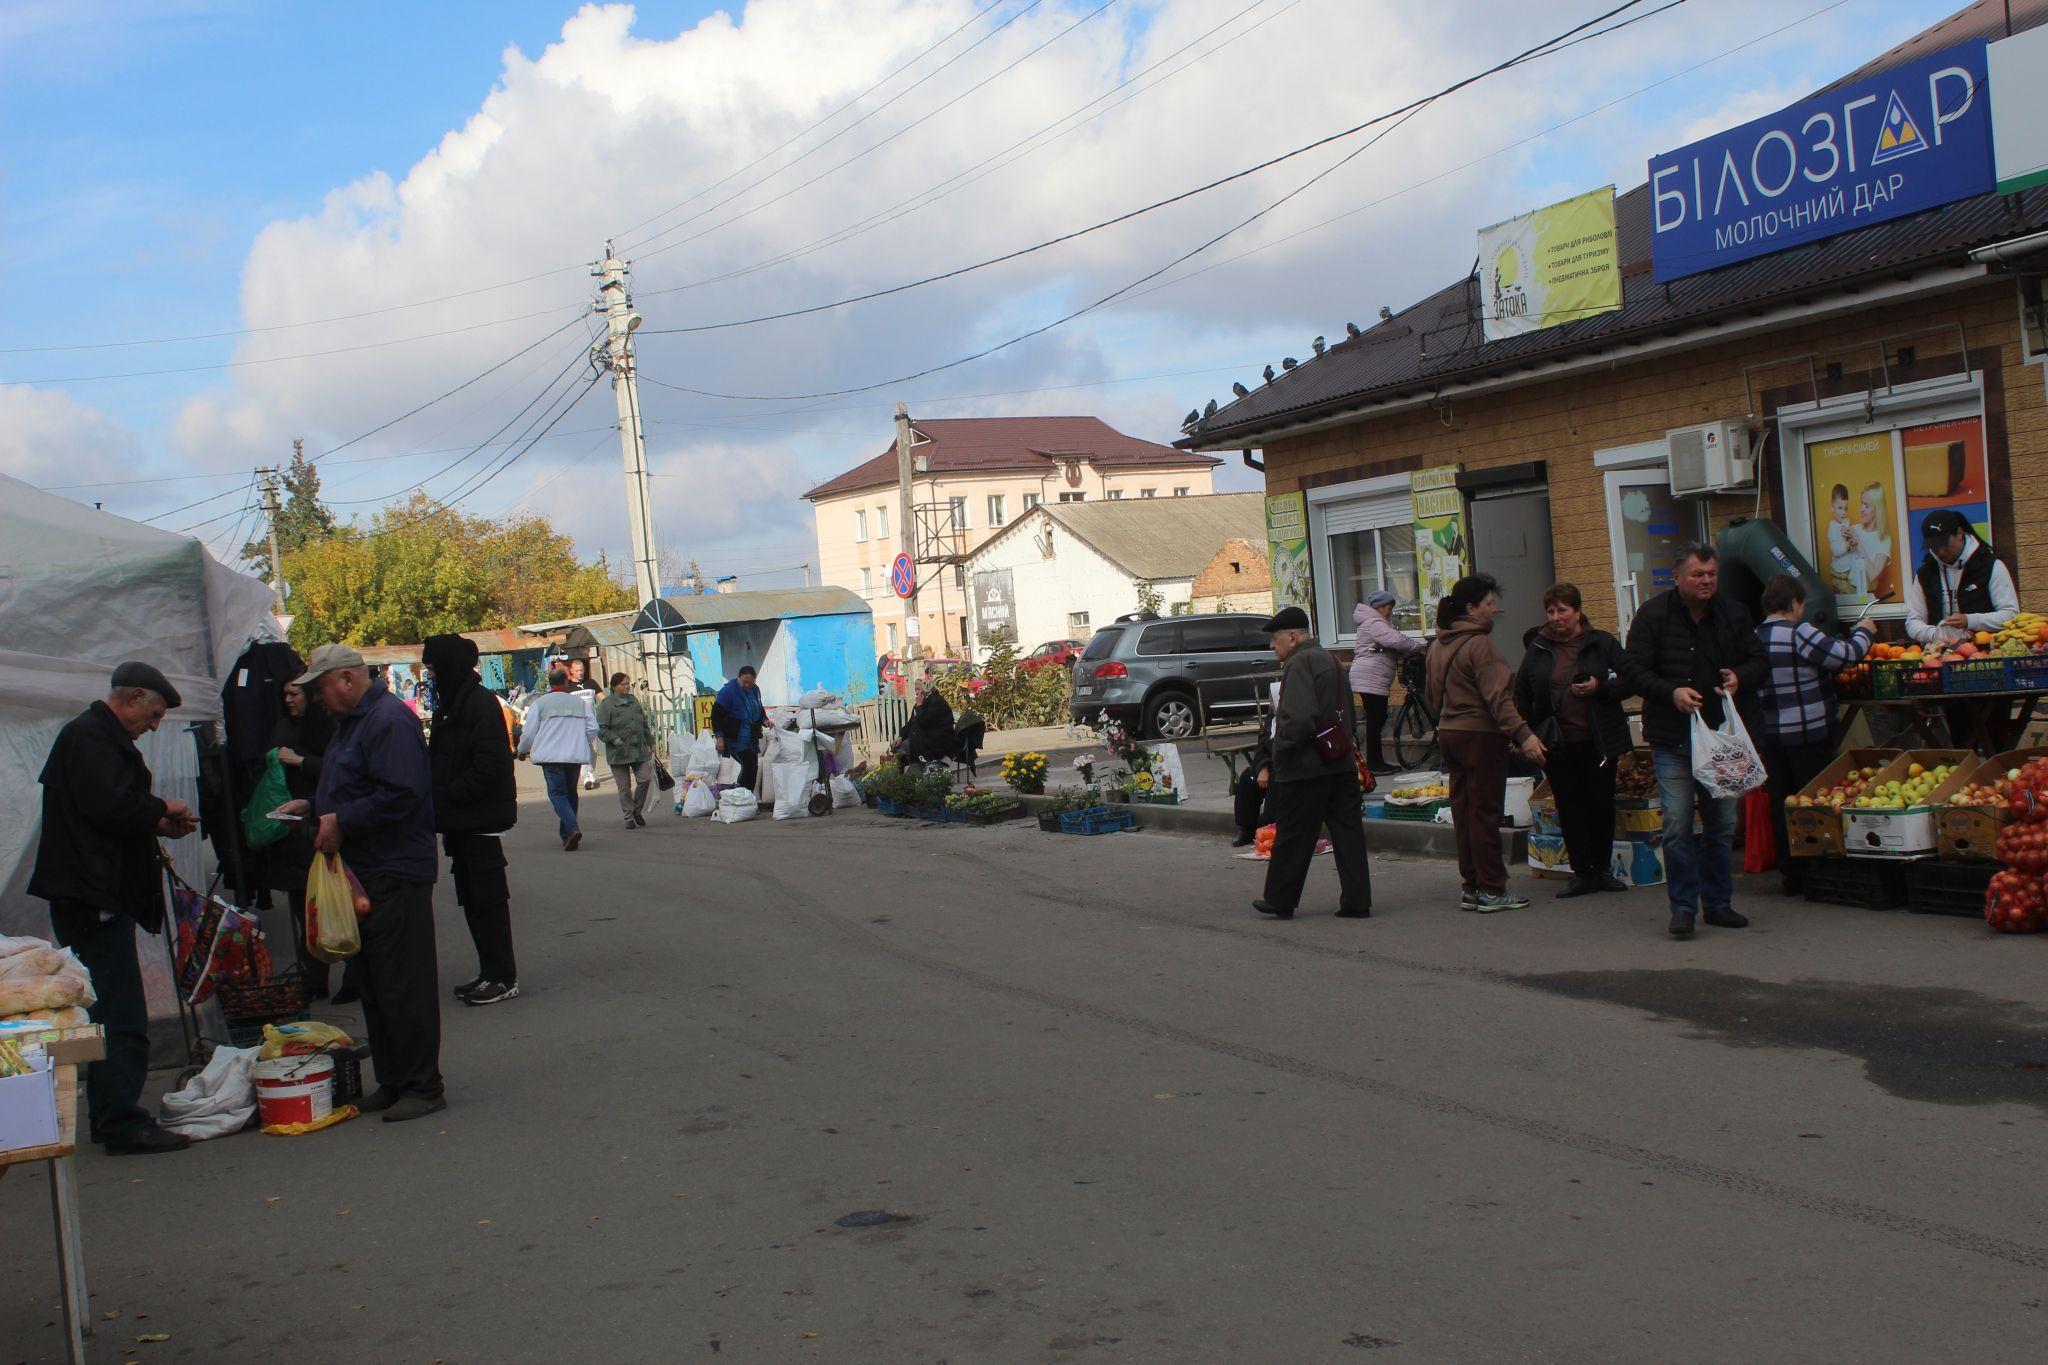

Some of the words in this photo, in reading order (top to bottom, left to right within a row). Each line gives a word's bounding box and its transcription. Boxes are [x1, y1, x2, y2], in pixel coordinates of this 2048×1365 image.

[1715, 185, 1845, 251] МОЛОЧНИЙ
[1852, 173, 1904, 216] ДАР
[1551, 242, 1570, 253] ТОВАРИ
[1570, 238, 1581, 248] ДЛЯ
[1551, 257, 1571, 269] ТОВАРИ
[1571, 254, 1582, 263] ДЛЯ
[1582, 247, 1609, 260] ТУРИЗМУ
[1551, 269, 1589, 285] ПНЕВМАТИЧНА
[1589, 263, 1610, 276] ЗБРОЯ
[1493, 292, 1528, 321] ЗАТОКА
[1823, 444, 1852, 457] ТИСЯЧІ
[1853, 439, 1880, 453] СІМЕЙ
